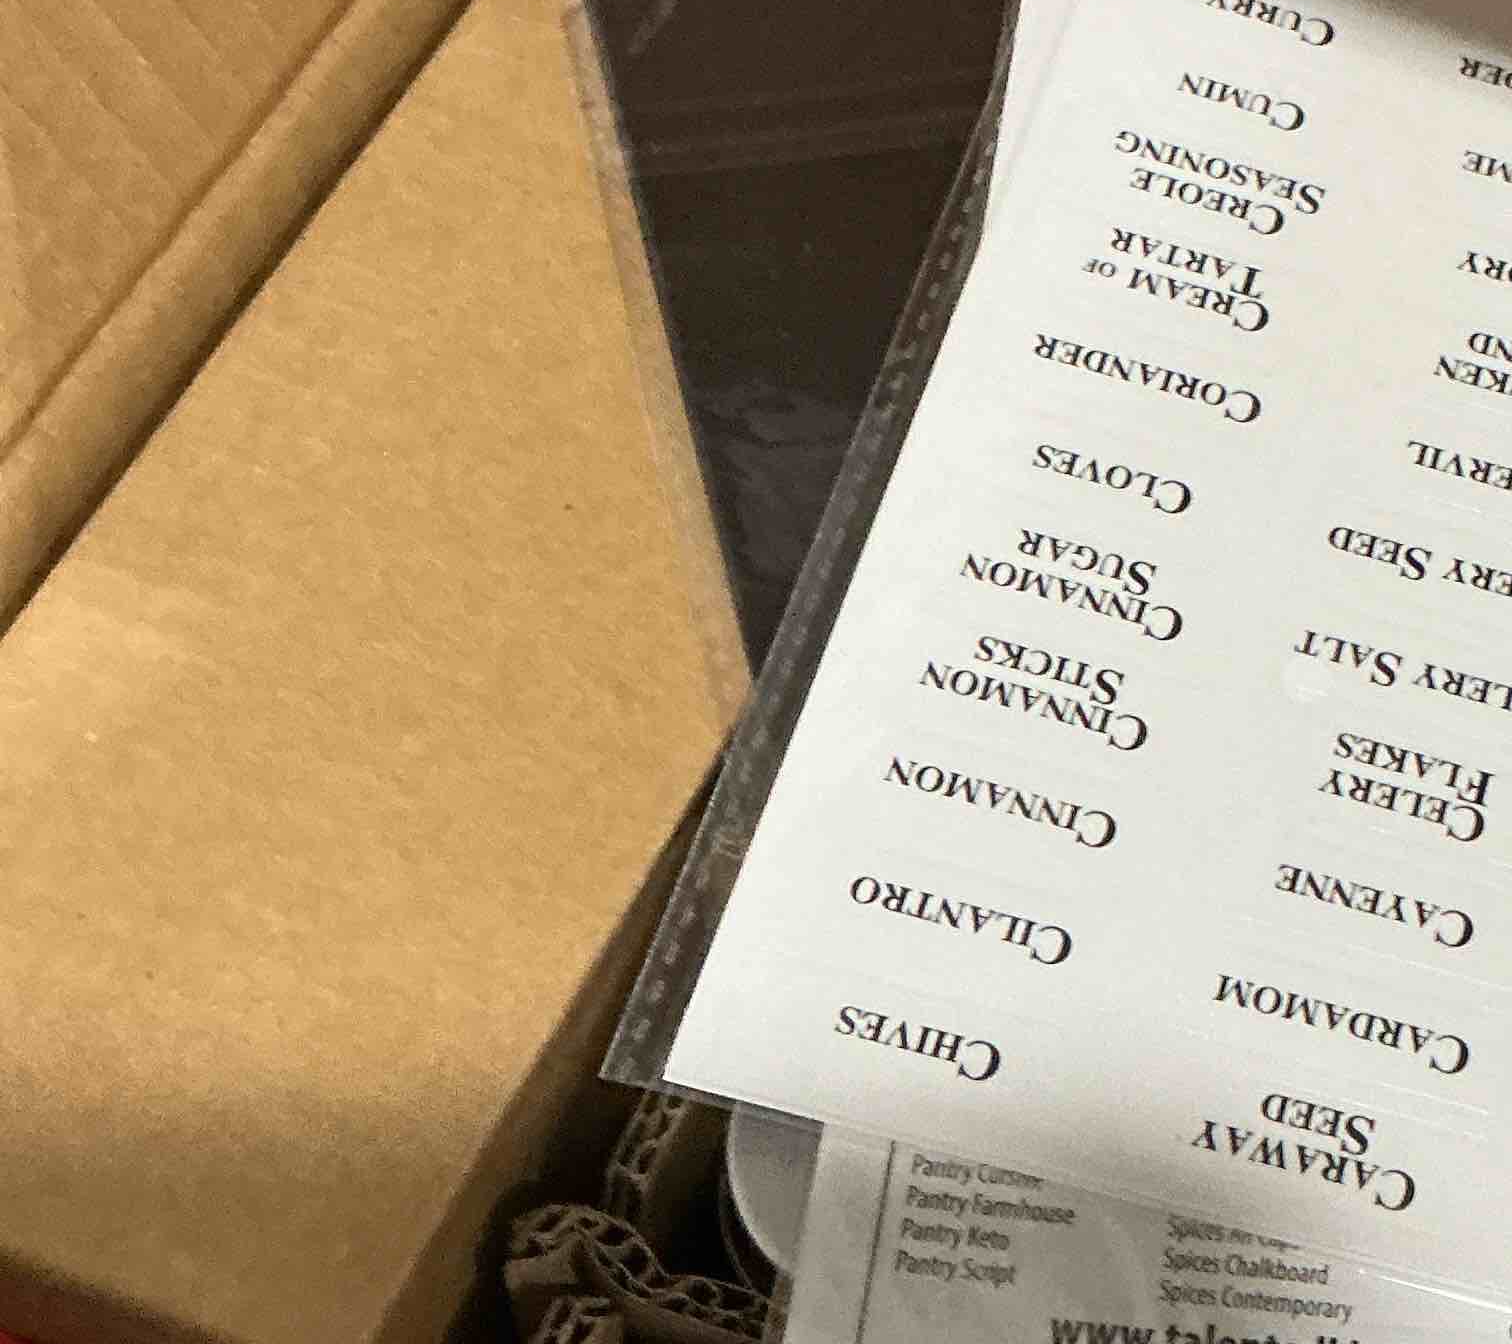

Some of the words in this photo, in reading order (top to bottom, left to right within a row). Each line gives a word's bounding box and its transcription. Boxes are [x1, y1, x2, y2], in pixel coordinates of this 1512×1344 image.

[1177, 71, 1306, 132] CUMIN
[1114, 129, 1326, 215] SEASONING
[1129, 167, 1286, 236] CREOLE
[1110, 227, 1263, 299] TARTAR
[1127, 268, 1270, 333] CREAM
[1033, 333, 1261, 424] CORIANDER
[1032, 444, 1192, 514] CLOVES
[1017, 528, 1158, 596] SUGAR
[1328, 526, 1432, 581] SEED
[960, 553, 1183, 641] CINNAMON
[973, 635, 1125, 706] STICKS
[1294, 629, 1404, 687] SALT
[919, 660, 1148, 752] CINNAMON
[883, 756, 1117, 848] CINNAMON
[1317, 768, 1485, 842] CELERY
[1333, 732, 1496, 807] FLAKES
[849, 875, 1072, 965] CILANTRO
[1274, 864, 1474, 948] CAYENNE
[834, 1005, 1001, 1081] CHIVES
[1212, 973, 1469, 1075] CARDAMOM
[1261, 1093, 1376, 1156] SEED
[1192, 1120, 1415, 1212] CARAWAY
[901, 1218, 961, 1249] Pantry
[967, 1225, 1011, 1250] Keto
[906, 1186, 968, 1218] Pantry
[971, 1193, 1077, 1225] Farmhouse
[895, 1249, 956, 1282] Pantry
[962, 1258, 1016, 1288] Script
[1159, 1279, 1217, 1308] Spices
[1220, 1285, 1354, 1324] Contemporary
[1162, 1249, 1221, 1276] Spices
[1224, 1254, 1330, 1286] Chalkboard
